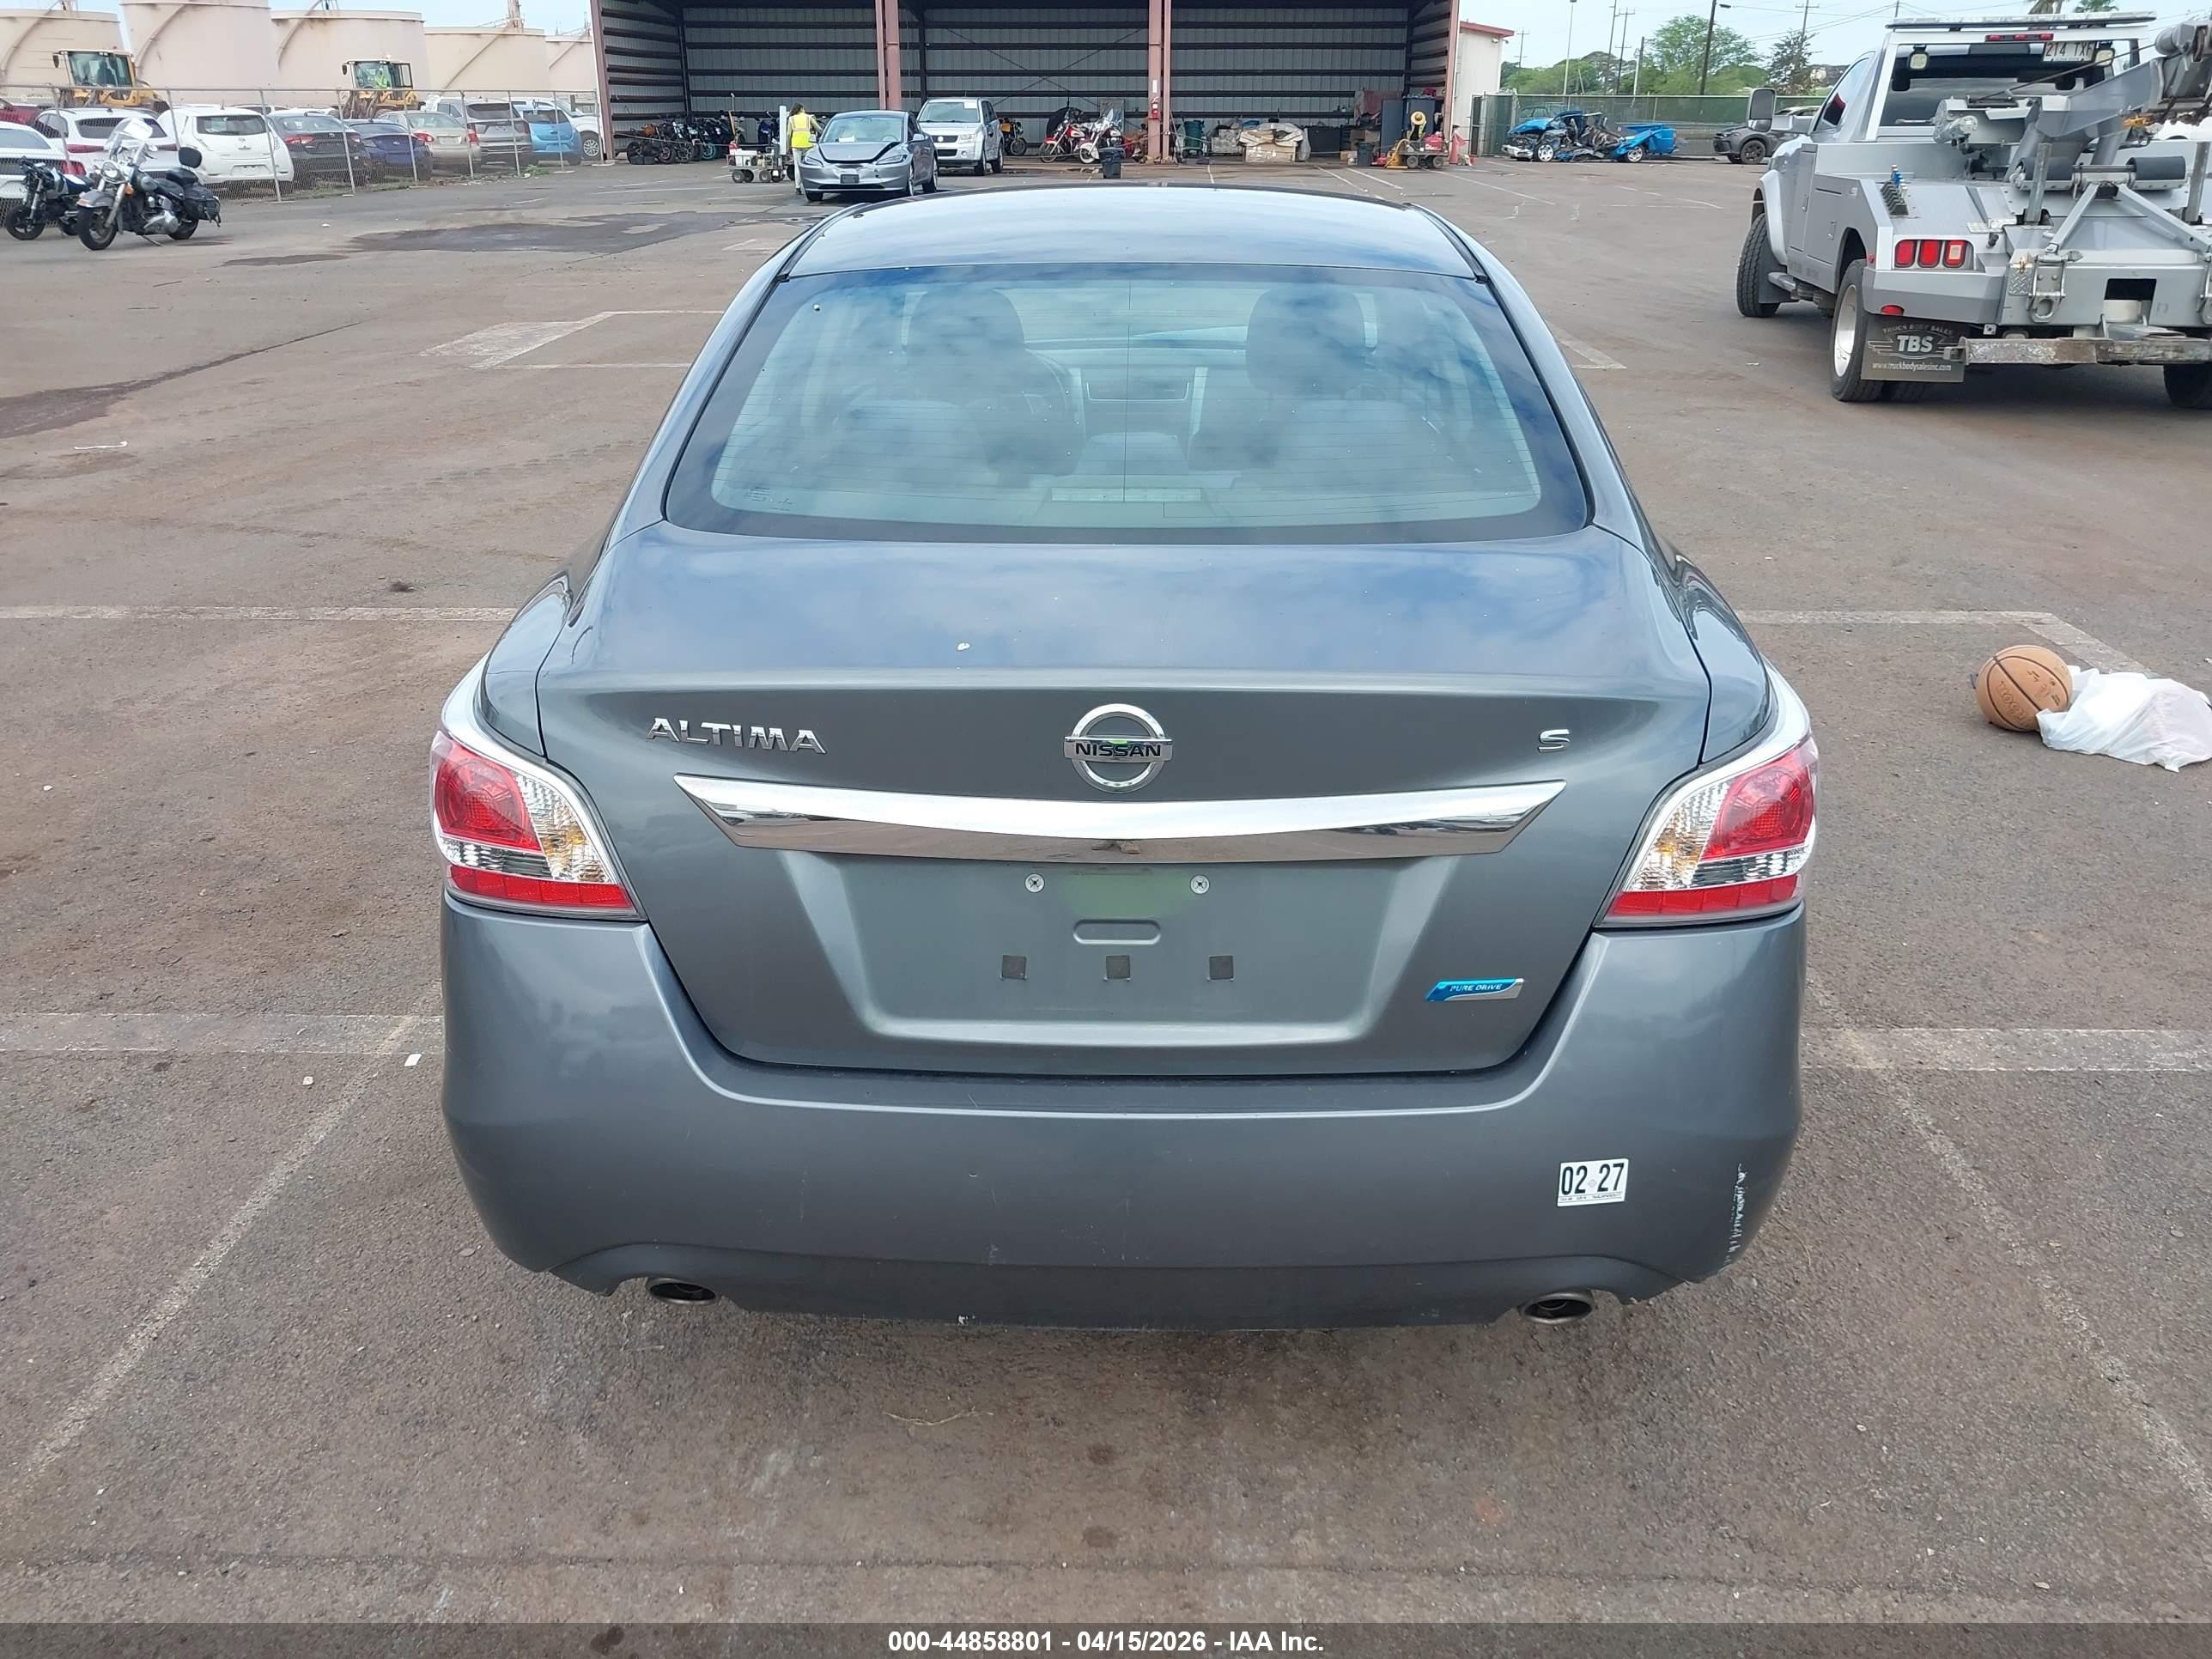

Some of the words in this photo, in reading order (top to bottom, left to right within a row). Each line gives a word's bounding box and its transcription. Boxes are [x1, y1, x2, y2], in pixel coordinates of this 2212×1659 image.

[2045, 42, 2067, 56] 214
[1897, 335, 1934, 353] TBS
[646, 717, 827, 754] ALTIMA
[1538, 728, 1571, 753] S
[1075, 742, 1161, 757] NISSAN
[1561, 1165, 1588, 1195] 02
[1597, 1162, 1625, 1192] 27
